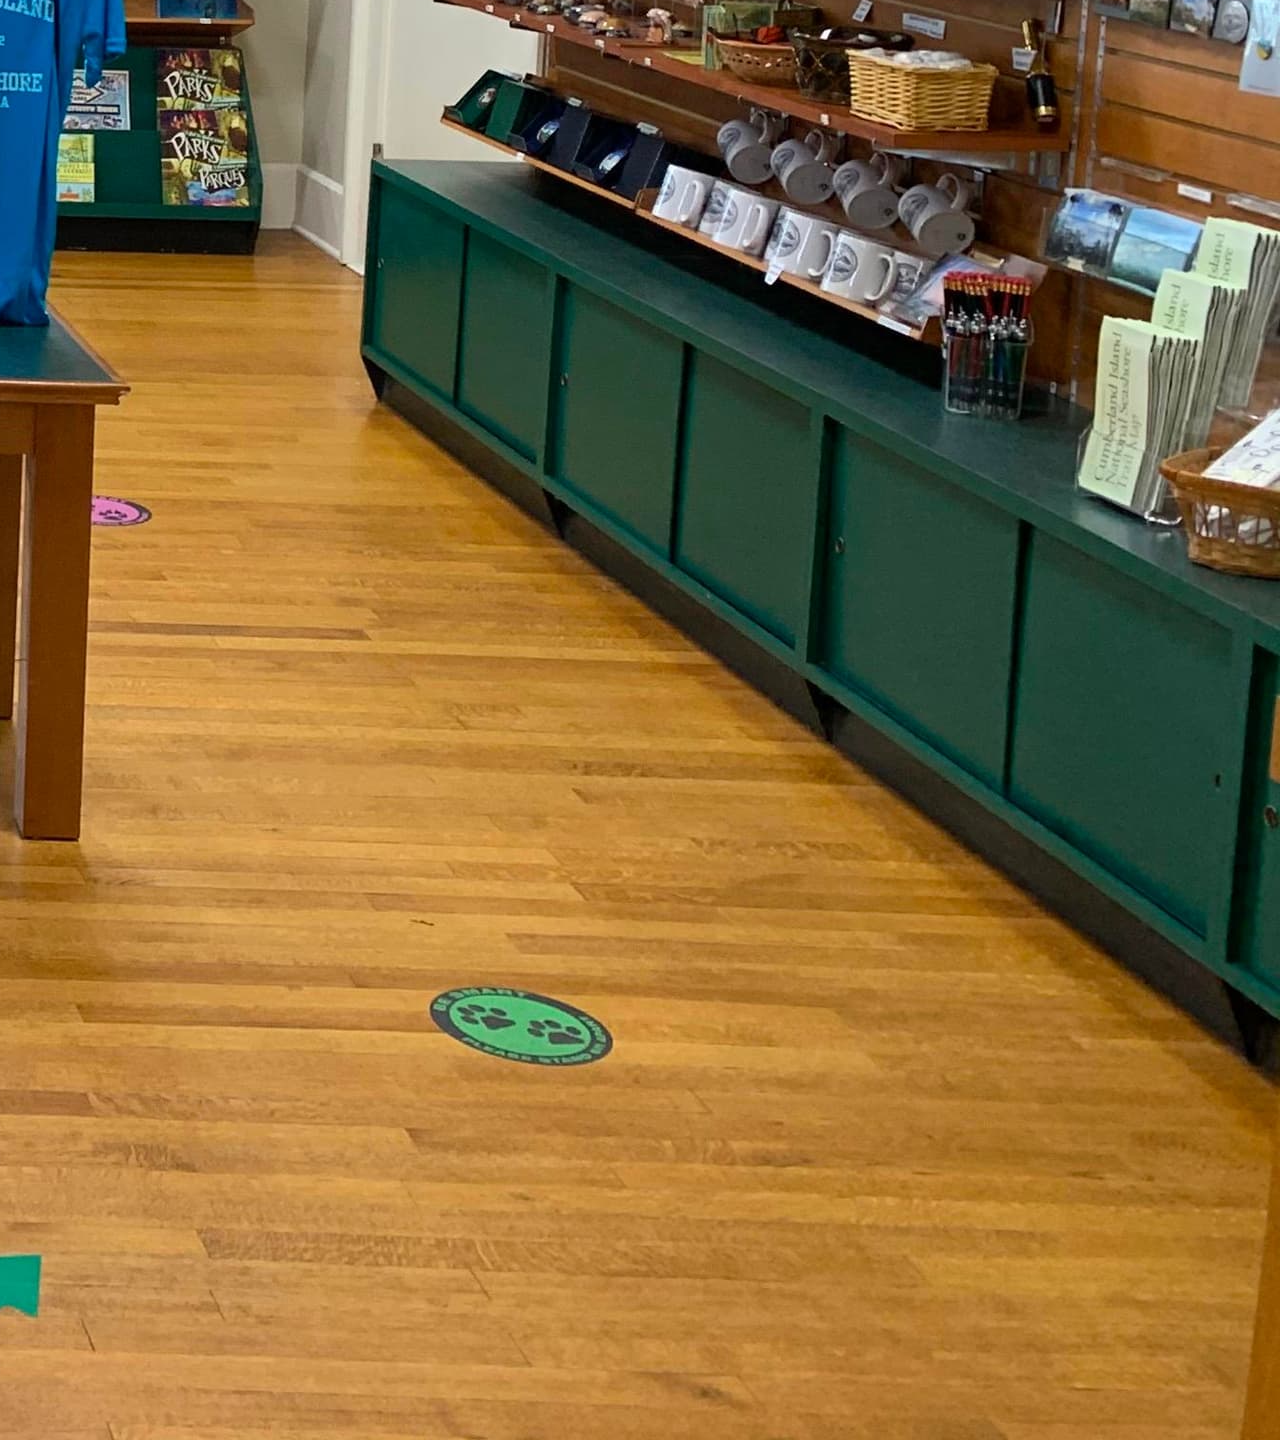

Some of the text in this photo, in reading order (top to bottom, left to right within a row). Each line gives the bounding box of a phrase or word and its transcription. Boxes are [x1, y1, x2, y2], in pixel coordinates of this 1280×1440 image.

[164, 70, 215, 104] PARKS
[171, 131, 223, 165] PARKS
[198, 166, 247, 190] PARQUES
[1094, 331, 1122, 482] Cumberland Island
[1105, 346, 1132, 485] National Seashore
